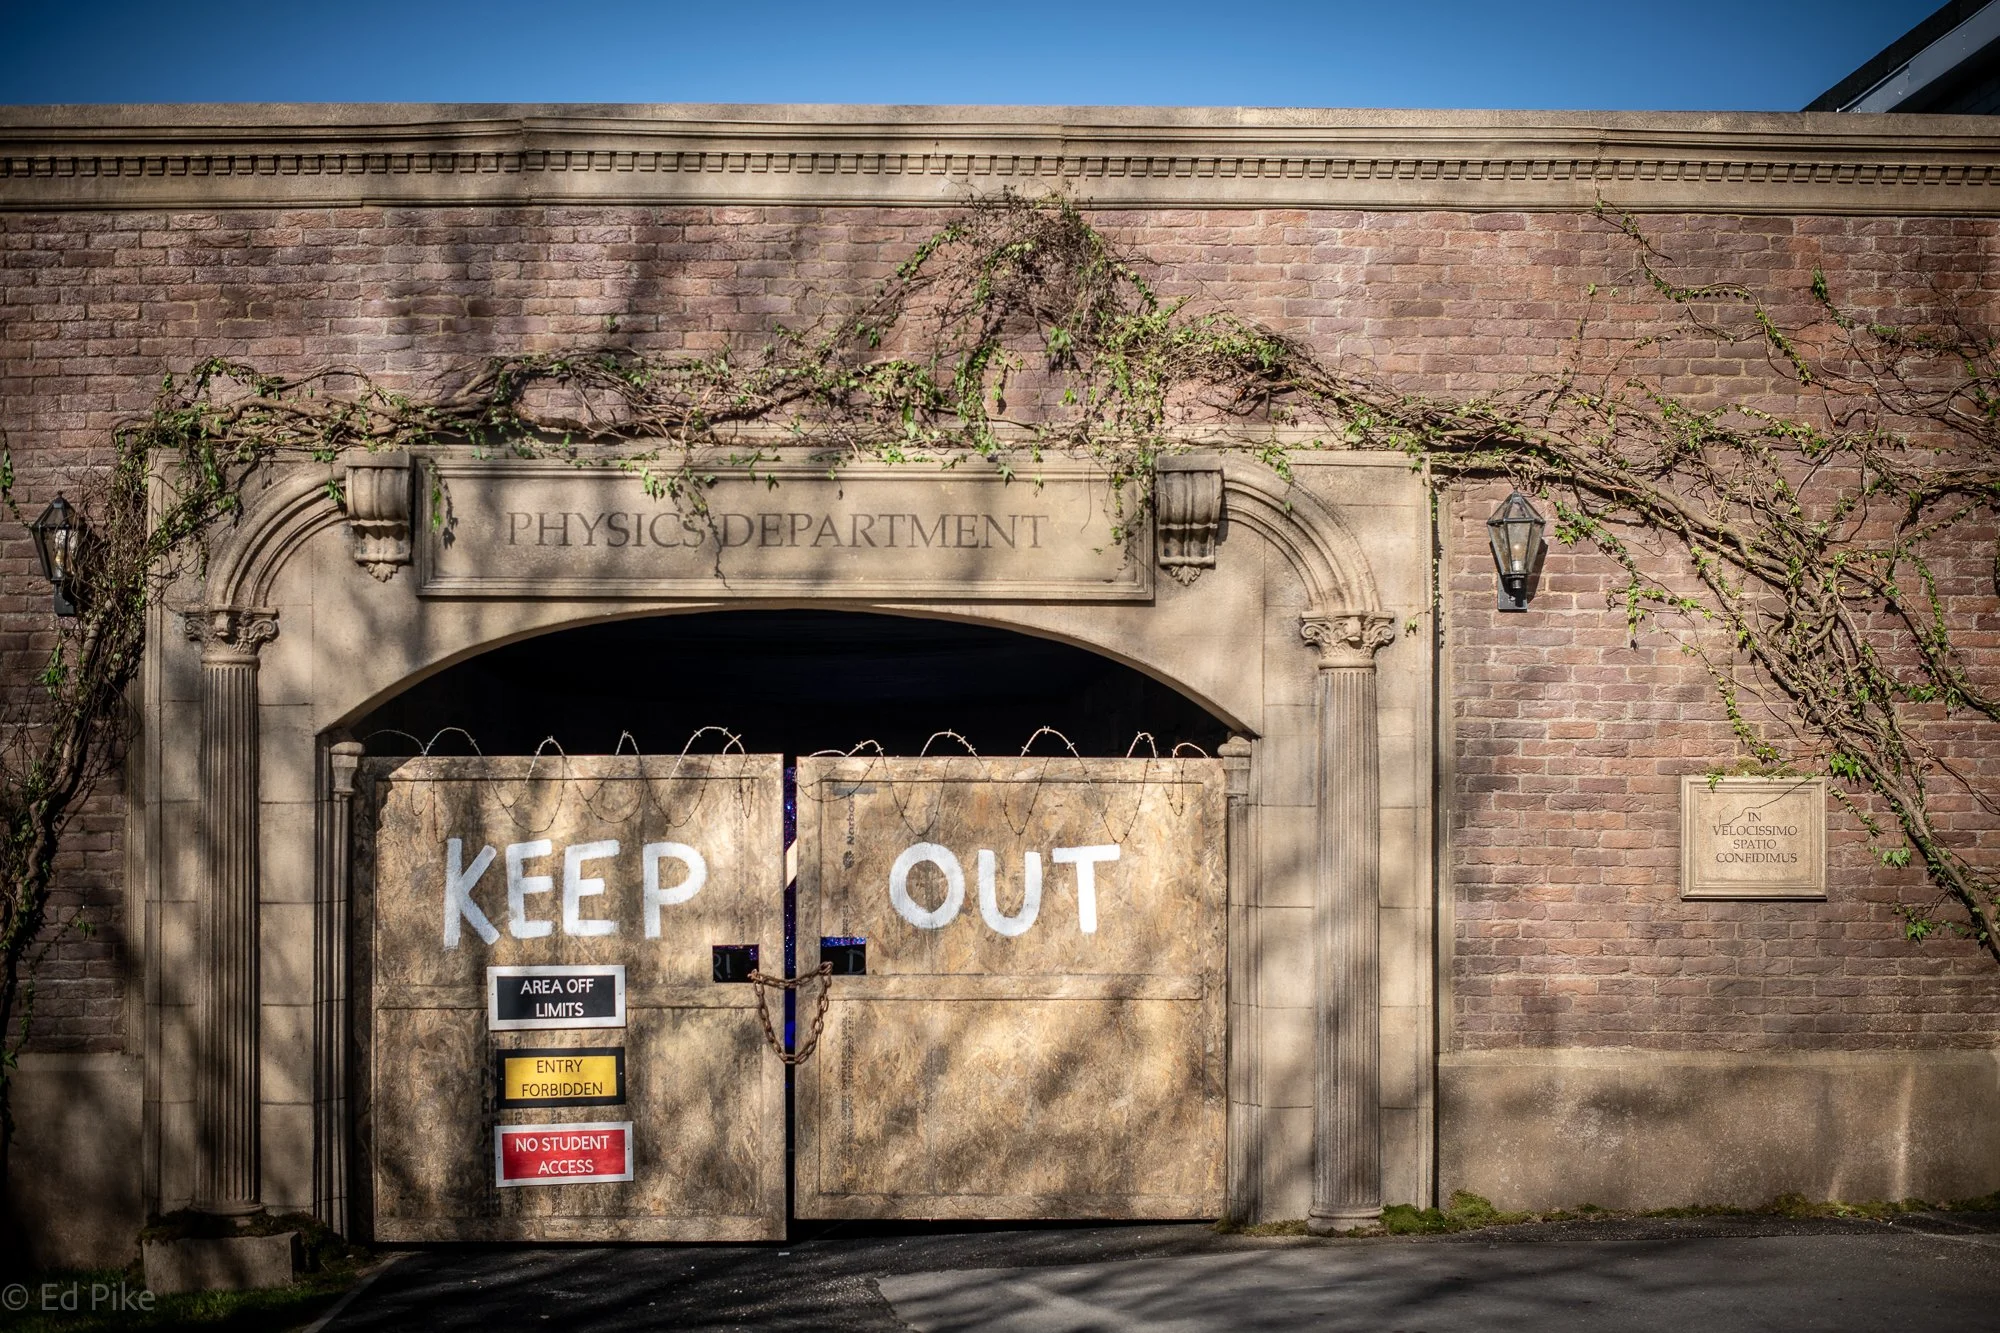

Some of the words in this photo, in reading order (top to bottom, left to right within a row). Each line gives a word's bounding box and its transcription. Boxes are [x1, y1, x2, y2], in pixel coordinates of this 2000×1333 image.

[505, 511, 706, 549] PHYSICS
[719, 511, 1049, 549] DEPARTMENT
[1747, 812, 1762, 822] IN
[1712, 825, 1798, 836] VELOCISSIMO
[1733, 839, 1777, 849] SPATIO
[1715, 852, 1798, 863] CONFIDIMUS
[443, 838, 706, 950] KEEP
[889, 842, 1121, 937] OUT
[520, 979, 563, 995] AREA
[566, 978, 595, 994] OFF
[536, 1002, 584, 1018] LIMITS
[536, 1059, 583, 1074] ENTRY
[522, 1082, 603, 1097] FORBIDDEN
[515, 1137, 538, 1152] NO
[542, 1135, 609, 1151] STUDENT
[537, 1159, 594, 1175] ACCESS
